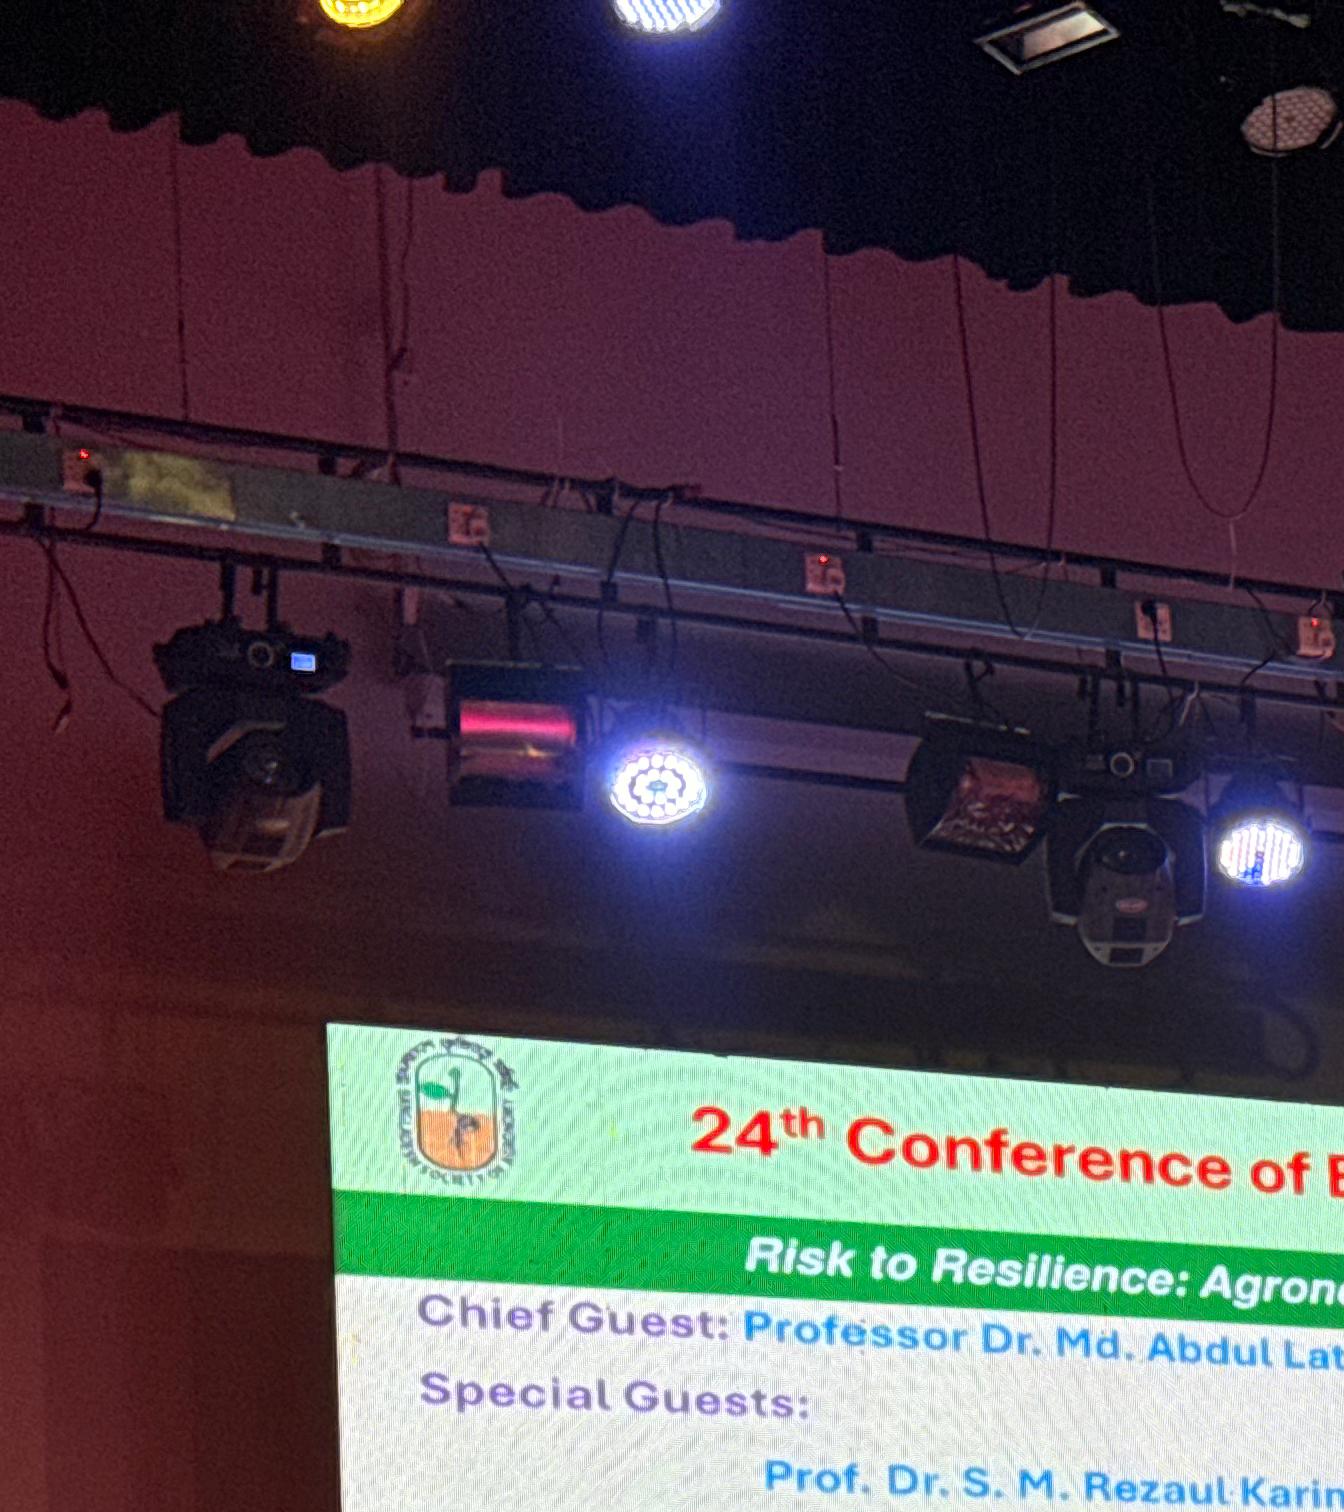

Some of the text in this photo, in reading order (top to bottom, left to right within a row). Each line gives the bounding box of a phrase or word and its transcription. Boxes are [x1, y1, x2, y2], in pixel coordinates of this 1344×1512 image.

[692, 1104, 825, 1157] 24th
[845, 1115, 1232, 1190] Conference
[1250, 1151, 1311, 1195] of
[744, 1235, 856, 1279] Risk
[869, 1244, 919, 1283] to
[931, 1246, 1191, 1298] Resilience:
[417, 1294, 553, 1332] Chief
[568, 1302, 729, 1342] Guest:
[743, 1309, 968, 1354] Professor
[981, 1324, 1042, 1358] Dr.
[1054, 1326, 1135, 1362] Md.
[1146, 1331, 1274, 1369] Abdul
[419, 1371, 809, 1420] Special Guests:
[764, 1459, 870, 1494] Prof.
[887, 1463, 949, 1497] Dr.
[962, 1465, 1004, 1499] S.
[1017, 1468, 1069, 1501] M.
[1083, 1470, 1229, 1506] Rezaul
